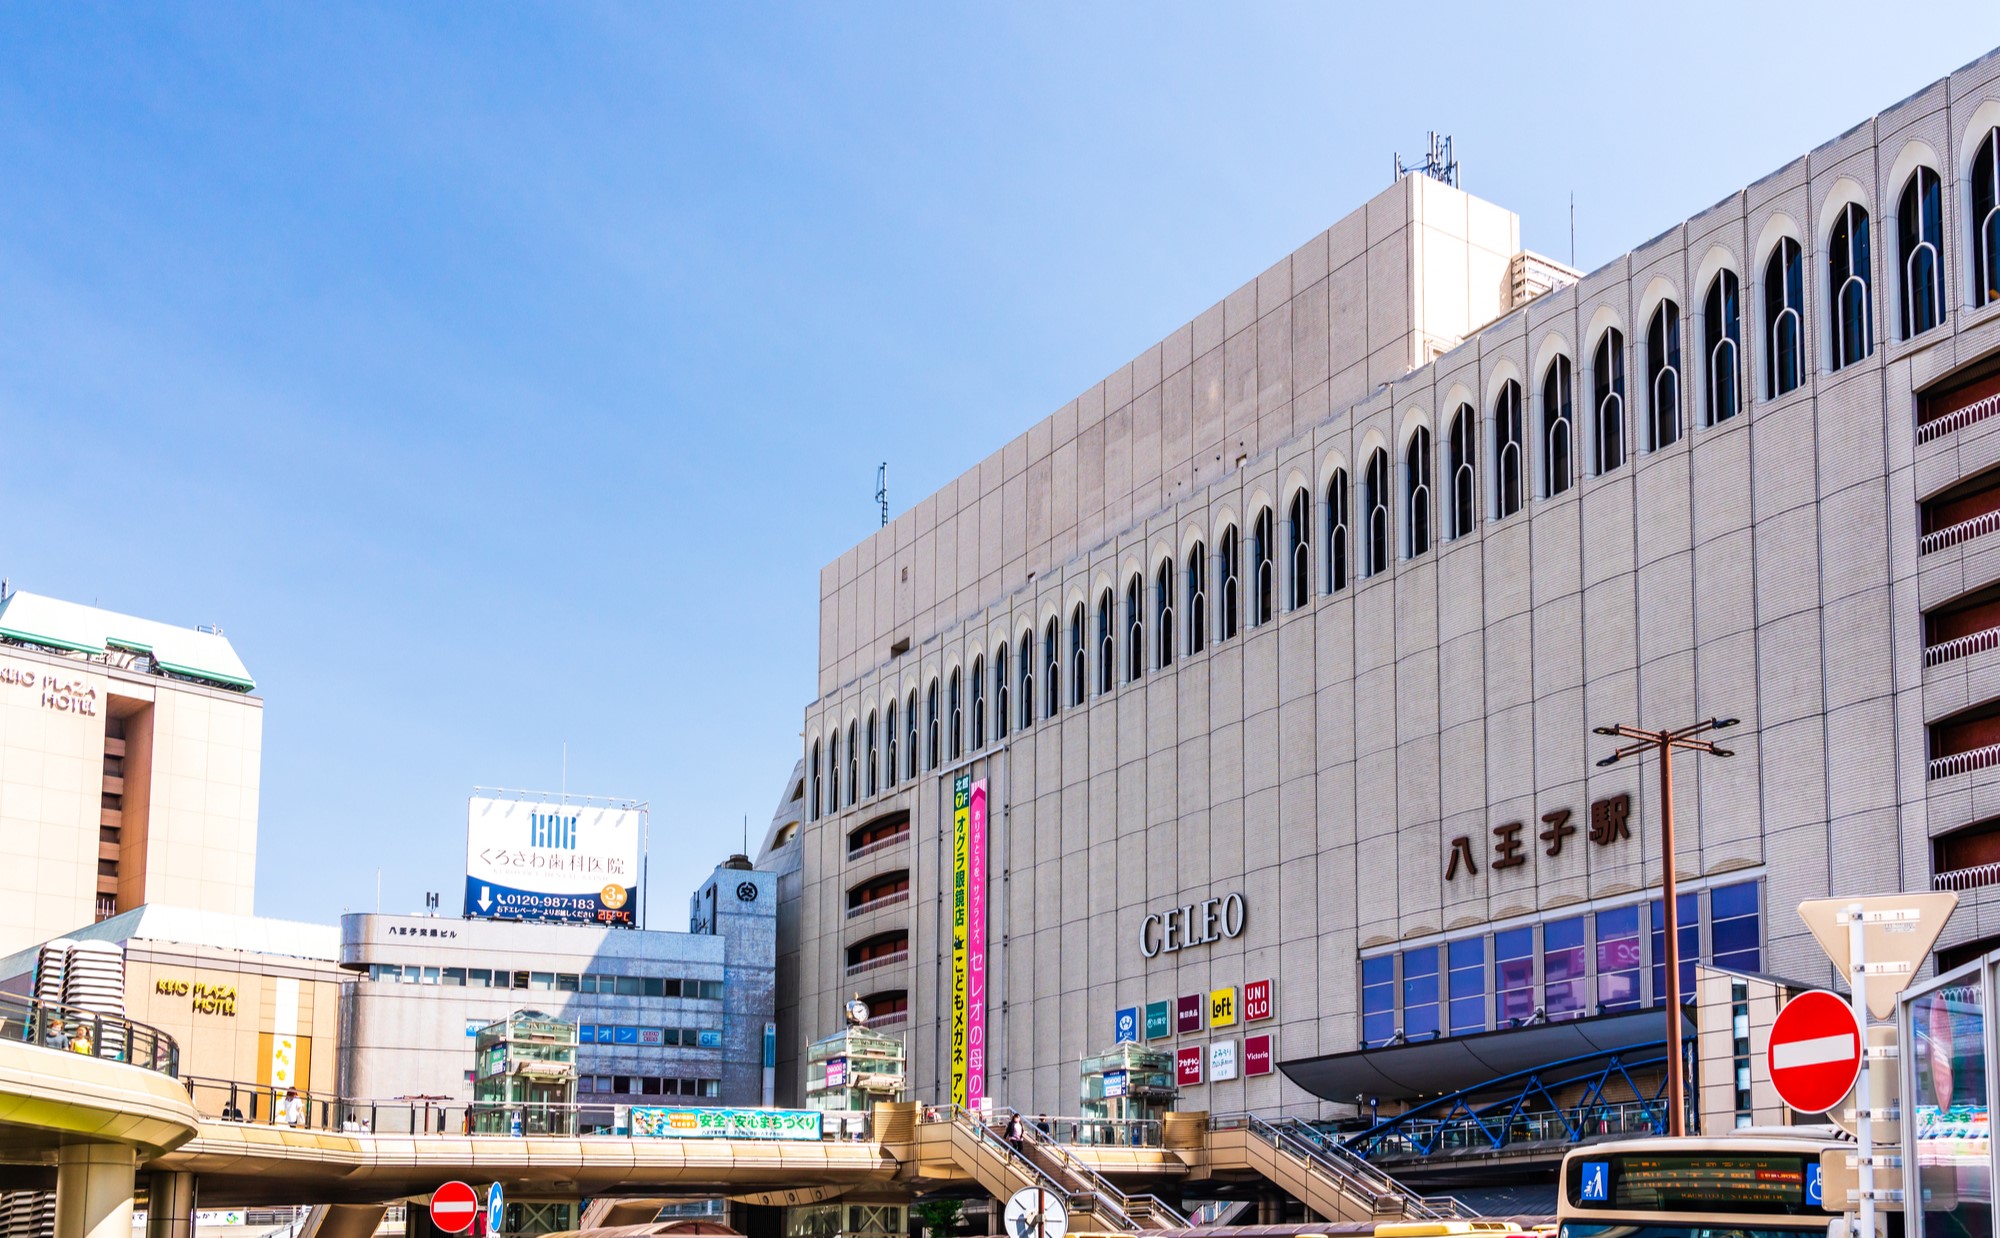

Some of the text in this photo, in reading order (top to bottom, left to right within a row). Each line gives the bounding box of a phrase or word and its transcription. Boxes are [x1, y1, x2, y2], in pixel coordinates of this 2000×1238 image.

[43, 675, 96, 700] PLAZA
[41, 692, 96, 717] HOTEL
[955, 777, 969, 791] 北館
[1445, 794, 1631, 881] 八王子駅
[480, 848, 625, 875] くろさわ歯科医院
[954, 815, 966, 927] オグラ眼鏡店
[506, 894, 595, 910] 0120-987-183
[1139, 892, 1245, 958] CELEO
[155, 978, 237, 1001] KEIO PLAZA
[1247, 985, 1265, 1001] UNI
[192, 997, 236, 1017] HOTEL
[954, 956, 964, 1065] こどもメガネ
[1247, 1000, 1267, 1018] QLO
[701, 1033, 718, 1045] 6F
[1247, 1051, 1268, 1060] Victoria
[699, 1113, 816, 1130] 安全・安心まちづくり
